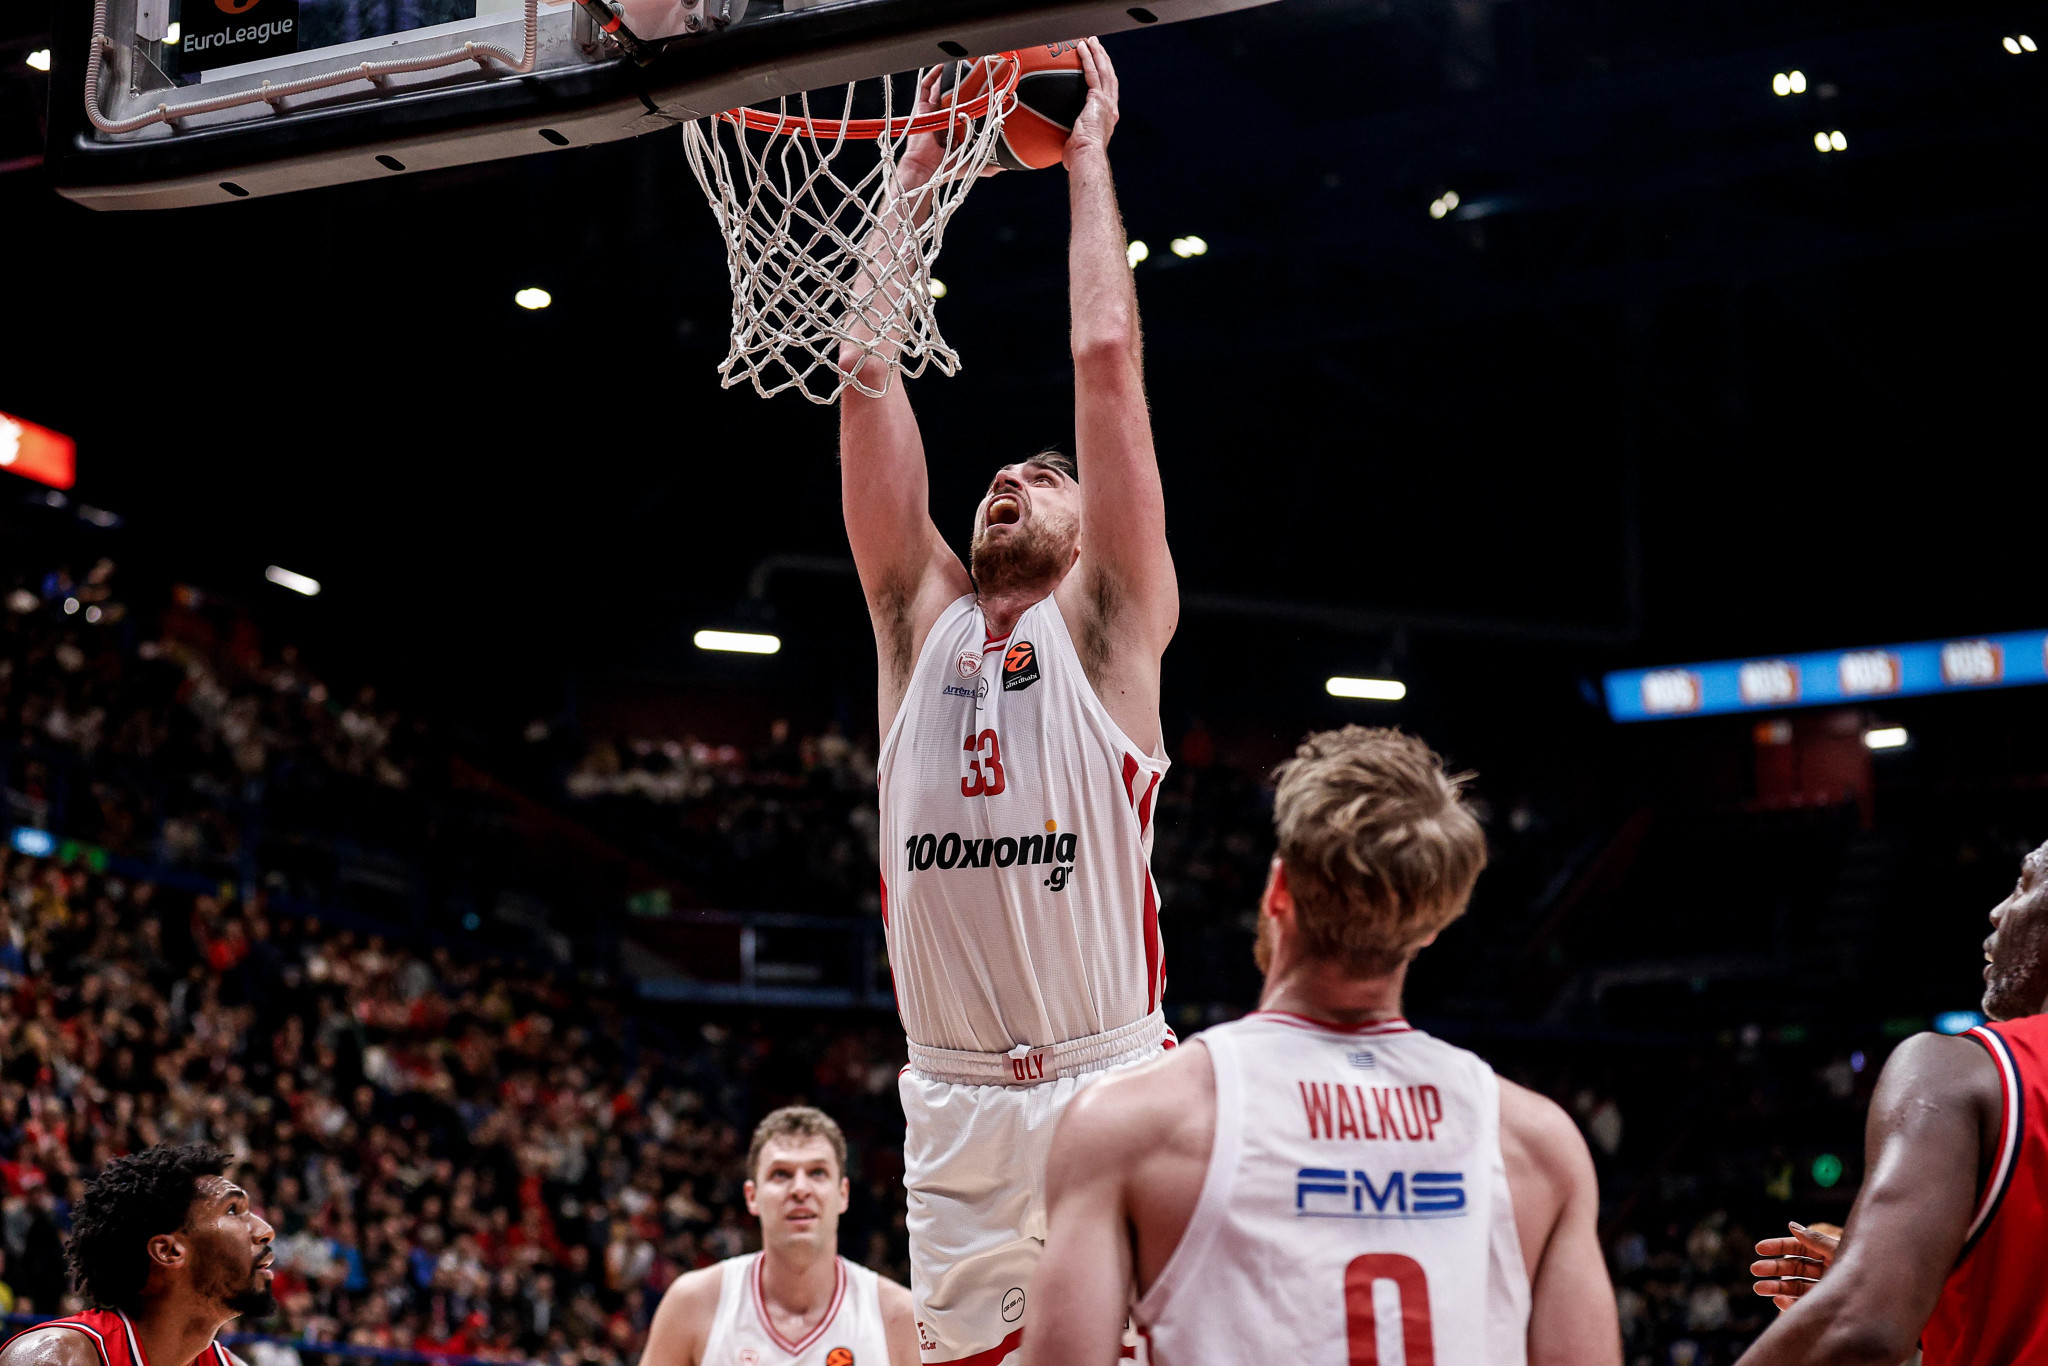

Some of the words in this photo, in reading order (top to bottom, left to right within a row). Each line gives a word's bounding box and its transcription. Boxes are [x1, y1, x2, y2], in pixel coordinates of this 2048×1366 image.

[183, 18, 293, 53] EuroLeague
[961, 728, 1006, 798] 33
[905, 819, 1078, 872] 100xronia
[1043, 865, 1074, 892] .gr
[1012, 1053, 1044, 1081] OLY
[1298, 1080, 1443, 1142] WALKUP
[1296, 1168, 1467, 1213] FMS
[1344, 1253, 1437, 1366] 0
